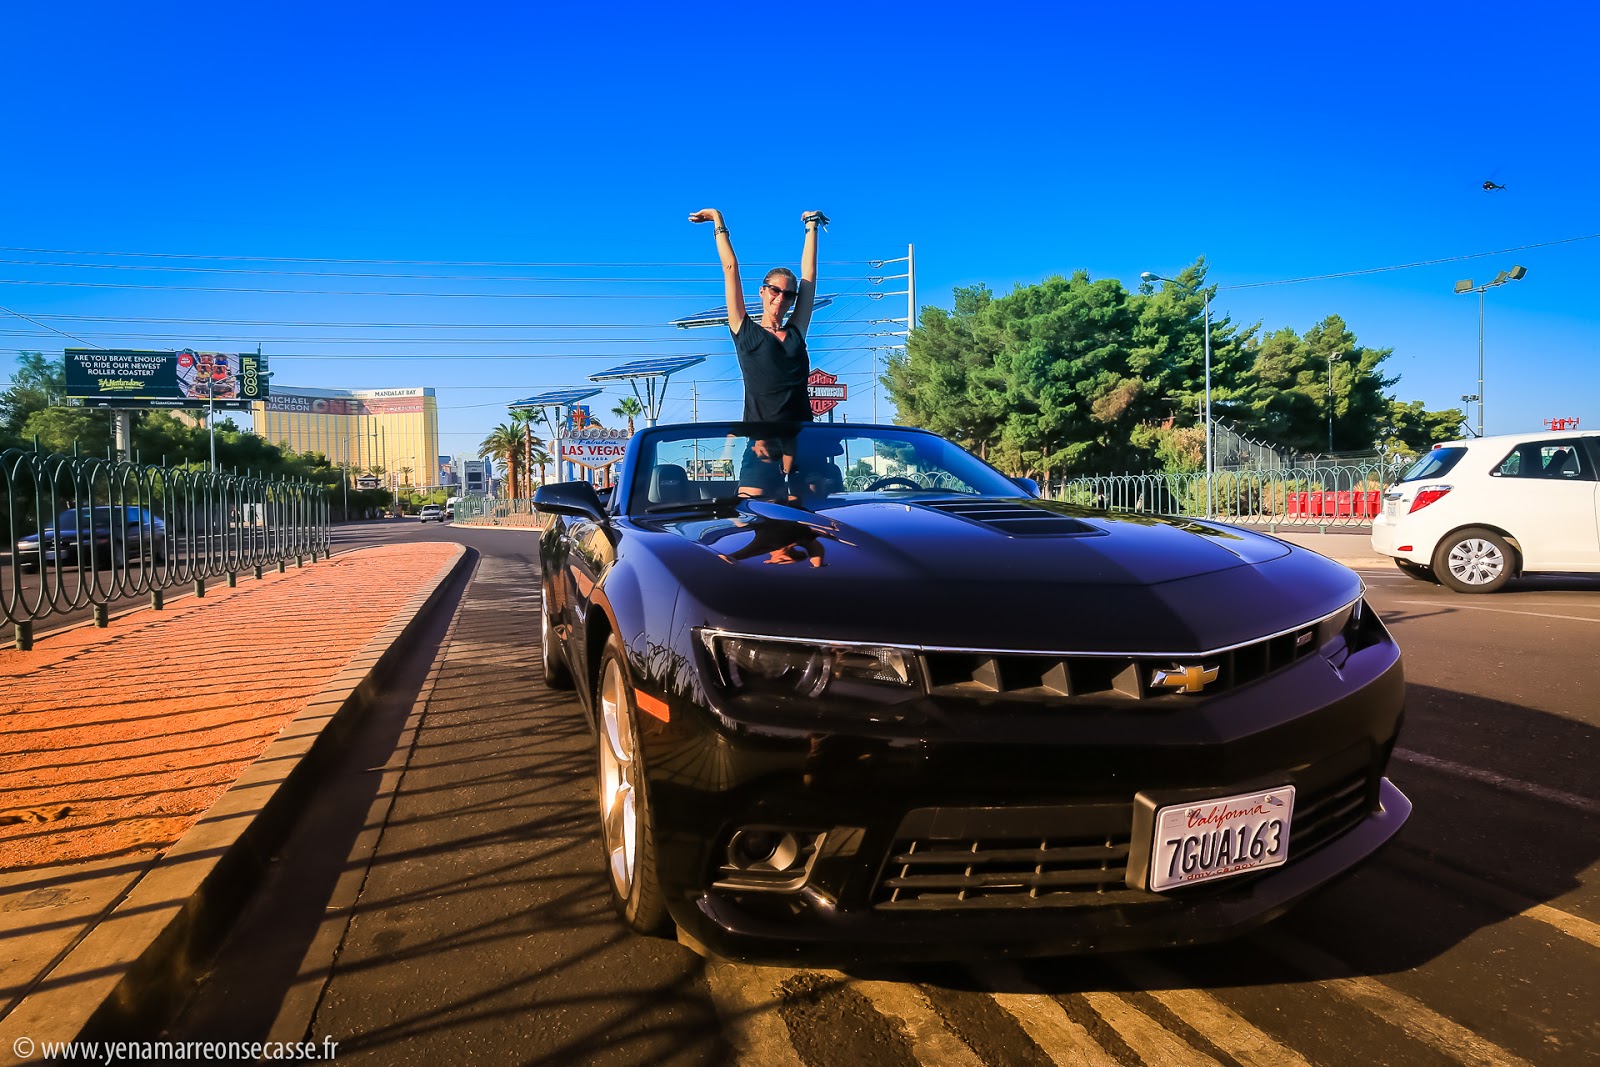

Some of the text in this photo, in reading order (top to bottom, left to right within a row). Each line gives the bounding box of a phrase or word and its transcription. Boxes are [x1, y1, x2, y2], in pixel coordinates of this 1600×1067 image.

[268, 396, 309, 405] MICHAEL
[313, 399, 358, 414] ONE
[560, 430, 627, 438] WELCOME
[562, 446, 625, 455] LAS VEGAS
[1188, 804, 1270, 828] California
[1166, 820, 1282, 878] 7GUA163
[1187, 862, 1256, 880] dmv.ca.gov
